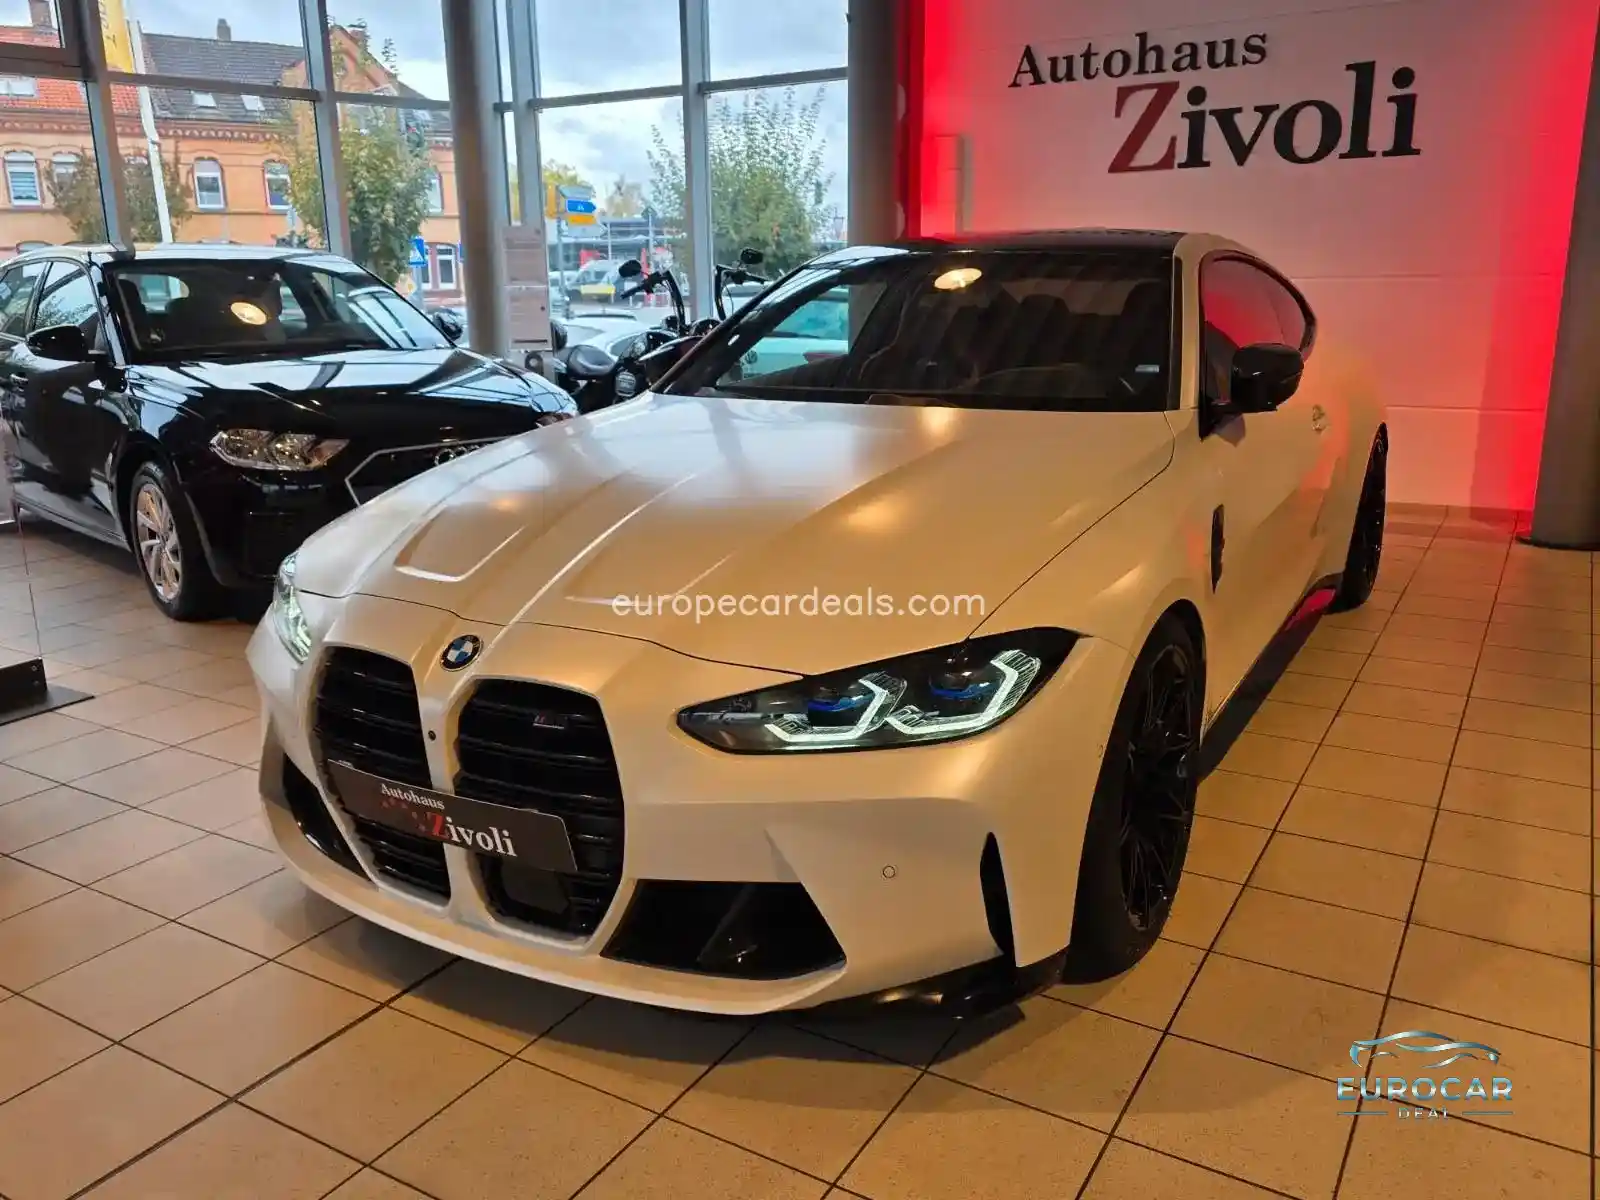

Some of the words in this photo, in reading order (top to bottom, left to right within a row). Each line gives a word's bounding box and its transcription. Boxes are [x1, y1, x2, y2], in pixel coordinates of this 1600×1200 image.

[1008, 32, 1267, 88] Autohaus
[1107, 60, 1421, 174] Zivoli
[380, 782, 446, 810] Autohaus
[425, 811, 518, 858] Zivoli
